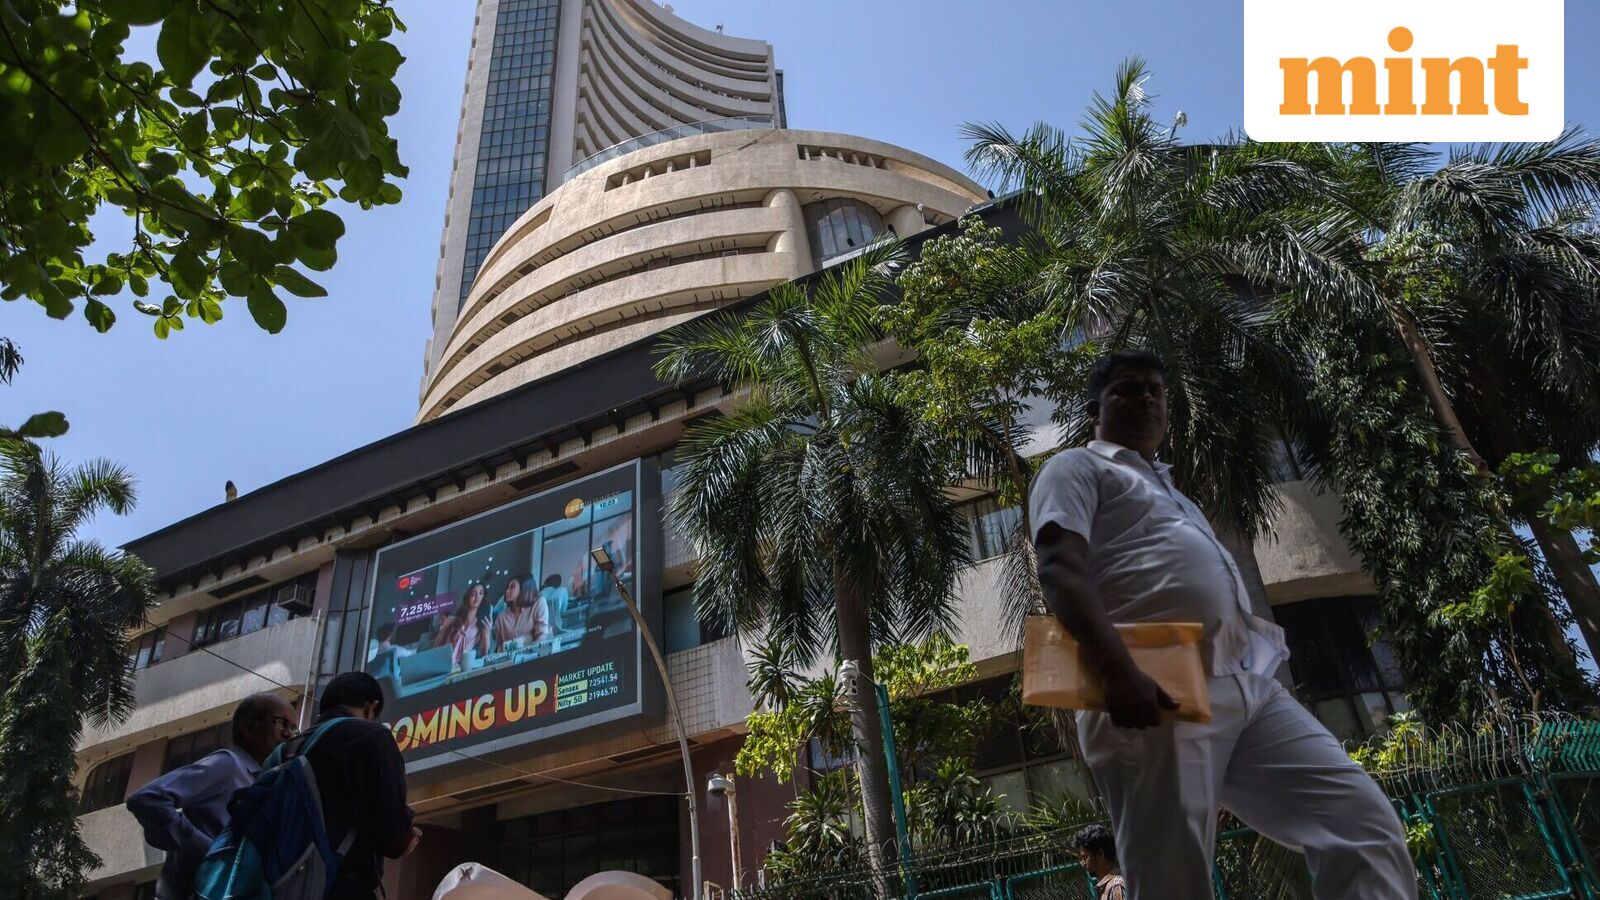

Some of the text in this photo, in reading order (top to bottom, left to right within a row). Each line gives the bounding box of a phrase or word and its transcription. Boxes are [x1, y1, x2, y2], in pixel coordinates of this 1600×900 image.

[558, 672, 618, 695] Sensex 72541.54
[559, 662, 614, 684] MARKET UPDATE
[558, 699, 572, 708] Nifty
[573, 694, 583, 704] 50
[382, 679, 548, 752] OMING UP
